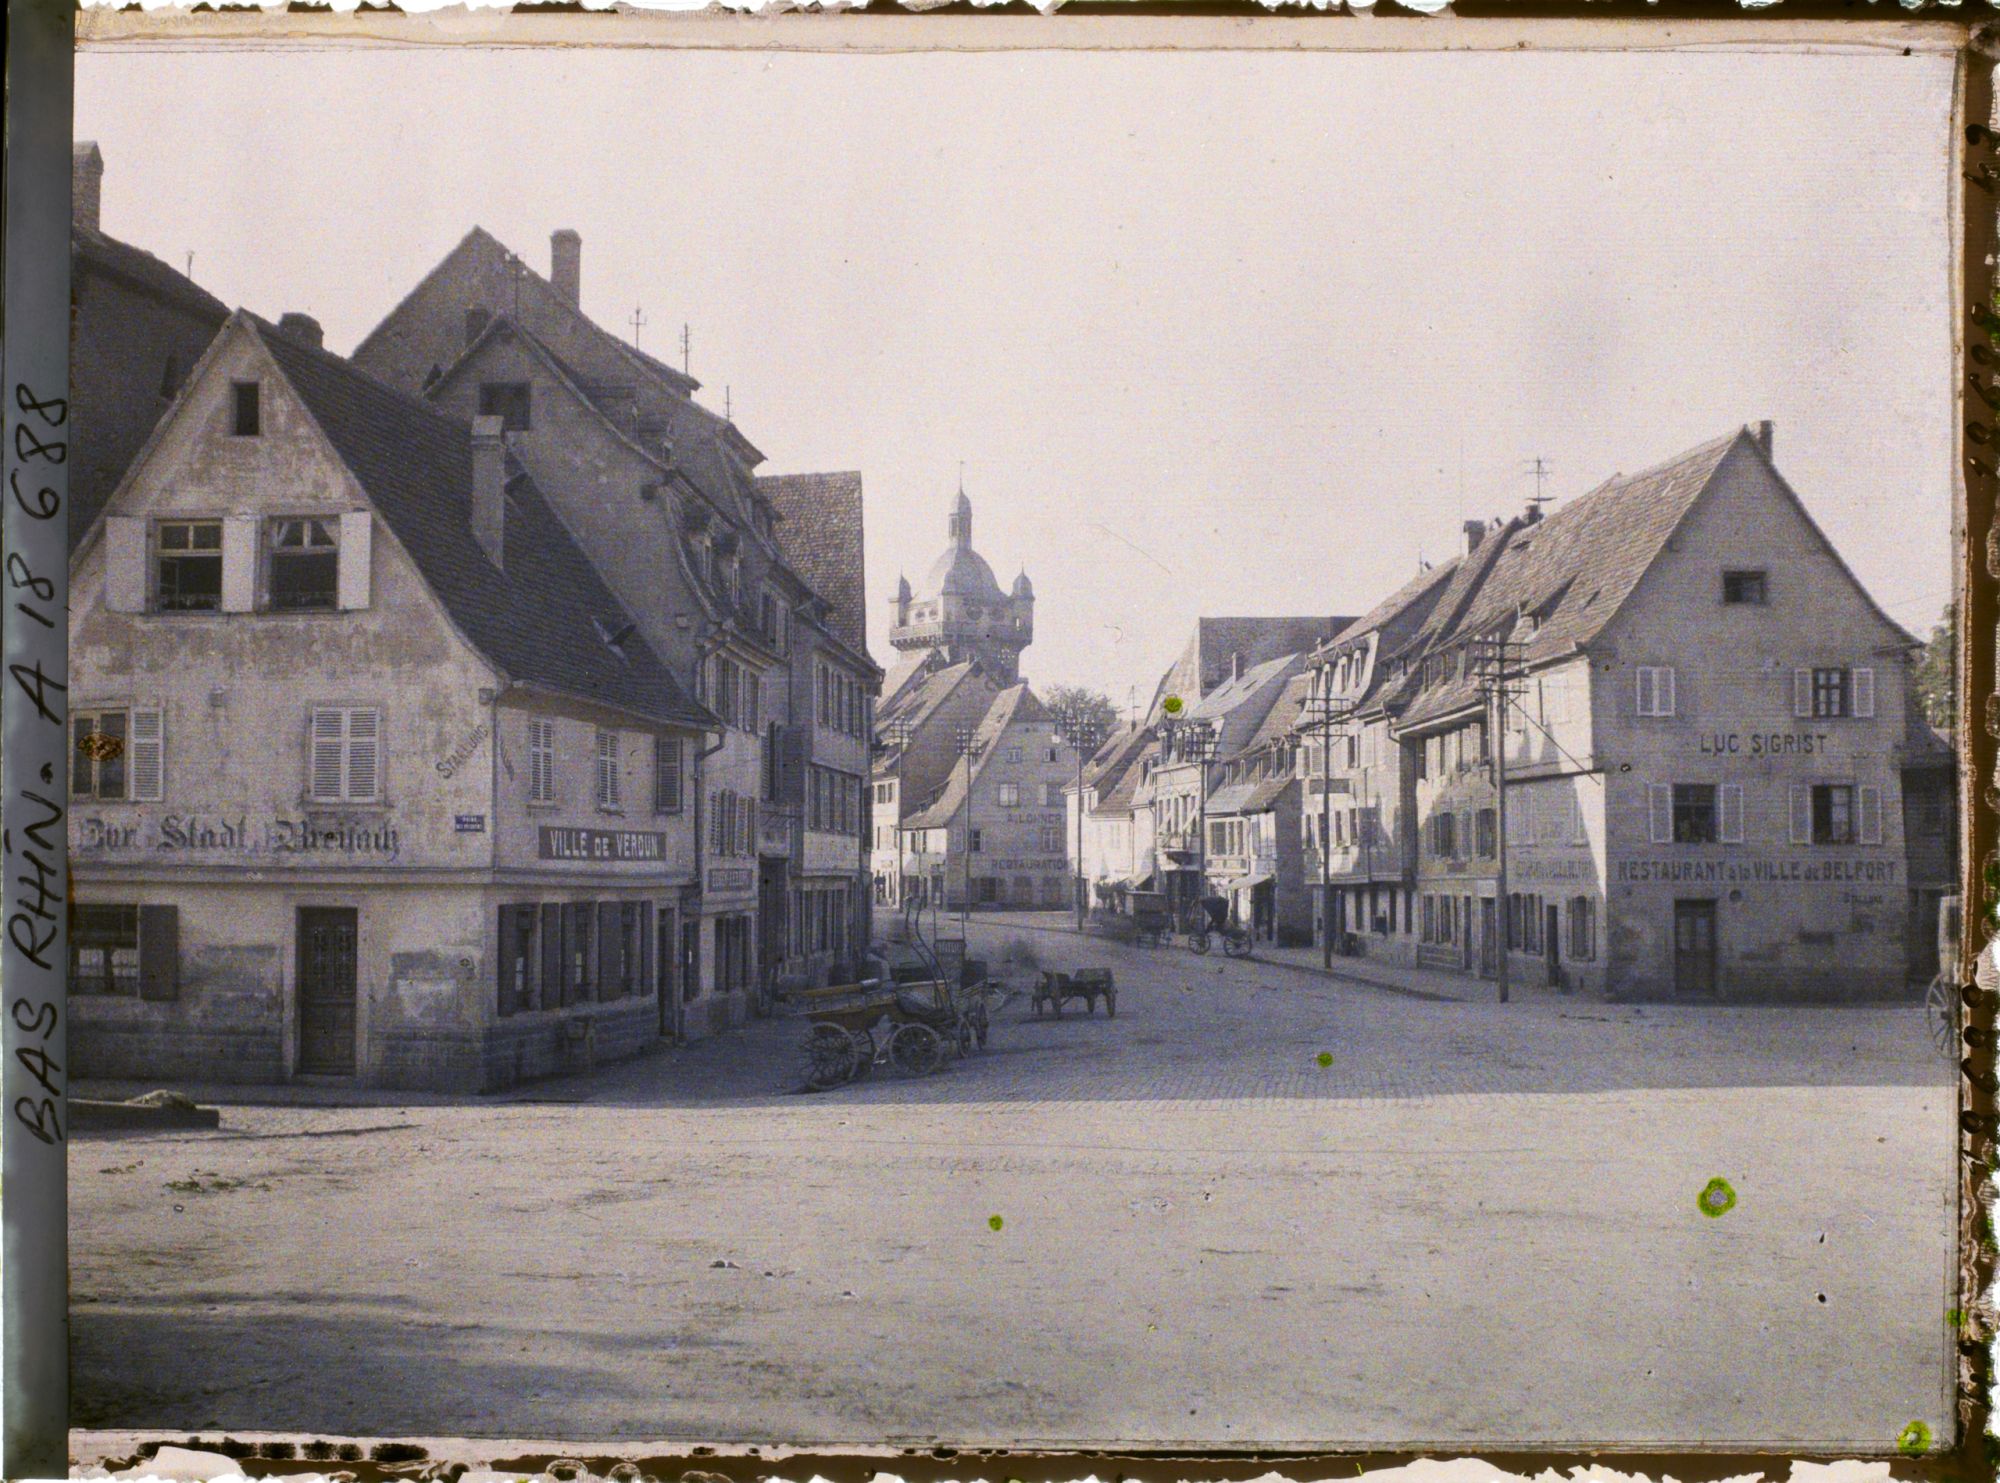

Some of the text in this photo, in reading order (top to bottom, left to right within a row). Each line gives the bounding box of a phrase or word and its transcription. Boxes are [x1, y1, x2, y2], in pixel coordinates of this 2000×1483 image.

[10, 383, 67, 520] 688
[7, 552, 55, 628] 18
[9, 660, 67, 726] A
[1700, 734, 1827, 753] LUC SIGRIST
[550, 830, 658, 857] VILLE DE VERDUN
[1618, 860, 1725, 880] RESTAURANT
[1754, 861, 1800, 880] VILLE
[1823, 861, 1896, 880] BELFORT
[12, 998, 63, 1145] BAS
